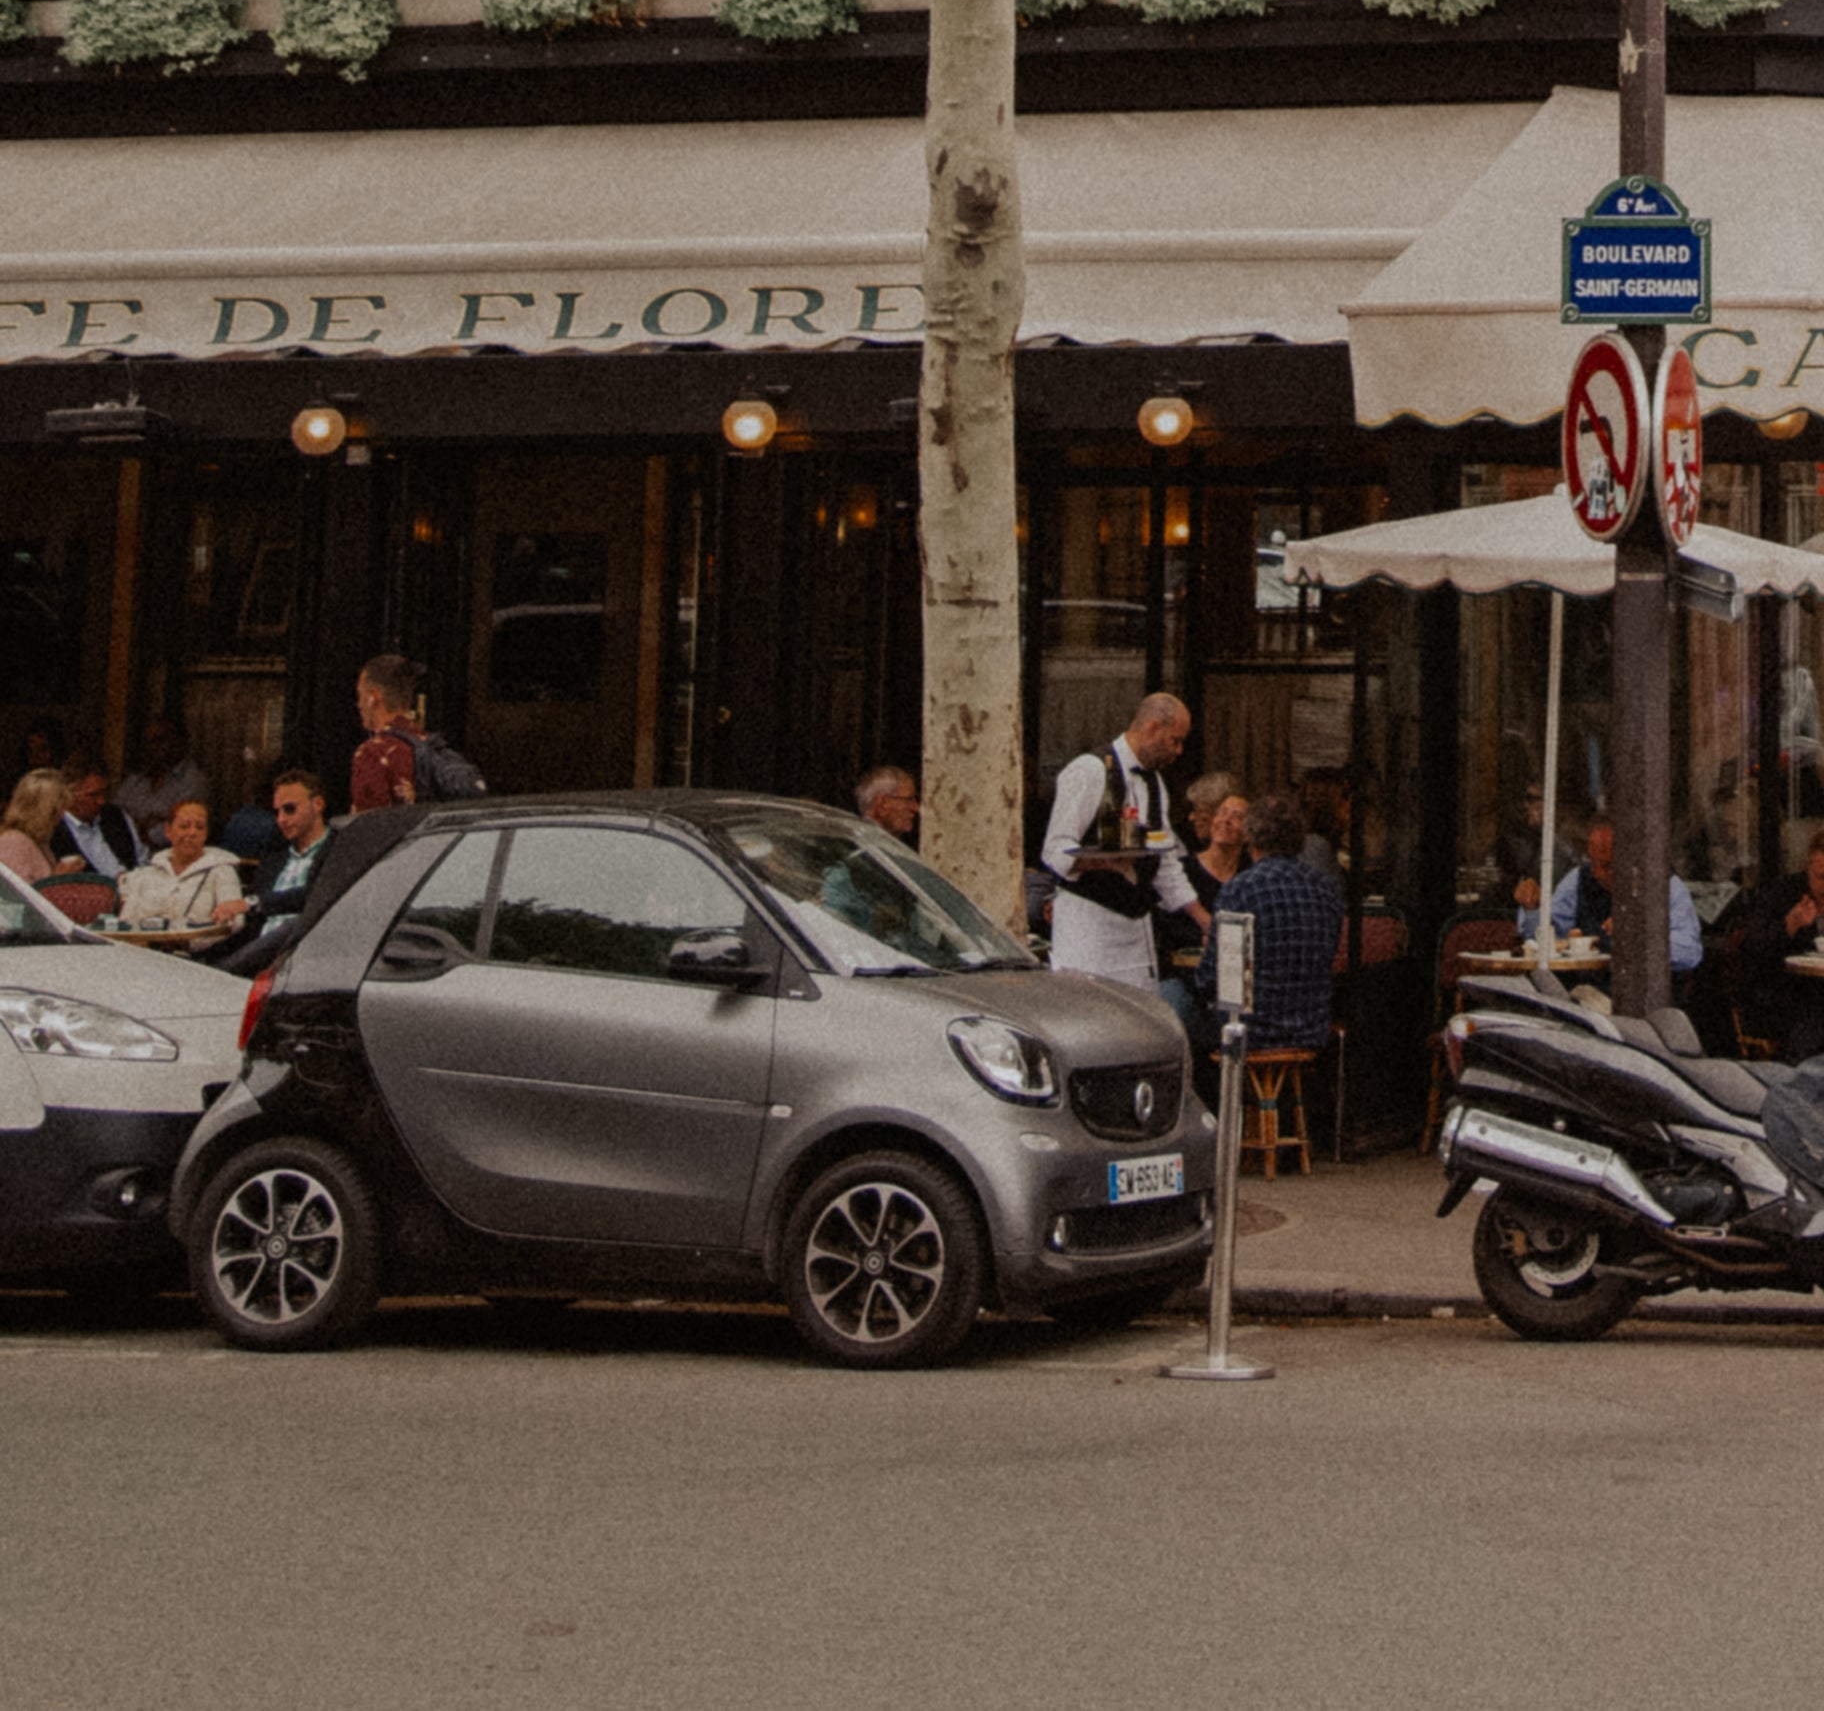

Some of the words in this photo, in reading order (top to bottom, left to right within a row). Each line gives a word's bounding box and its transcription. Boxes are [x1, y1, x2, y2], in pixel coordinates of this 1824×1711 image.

[1582, 245, 1690, 264] BOULEVARD
[1575, 279, 1699, 297] SAINT-GERMAIN
[207, 295, 387, 345] DE
[451, 284, 926, 340] FLORE
